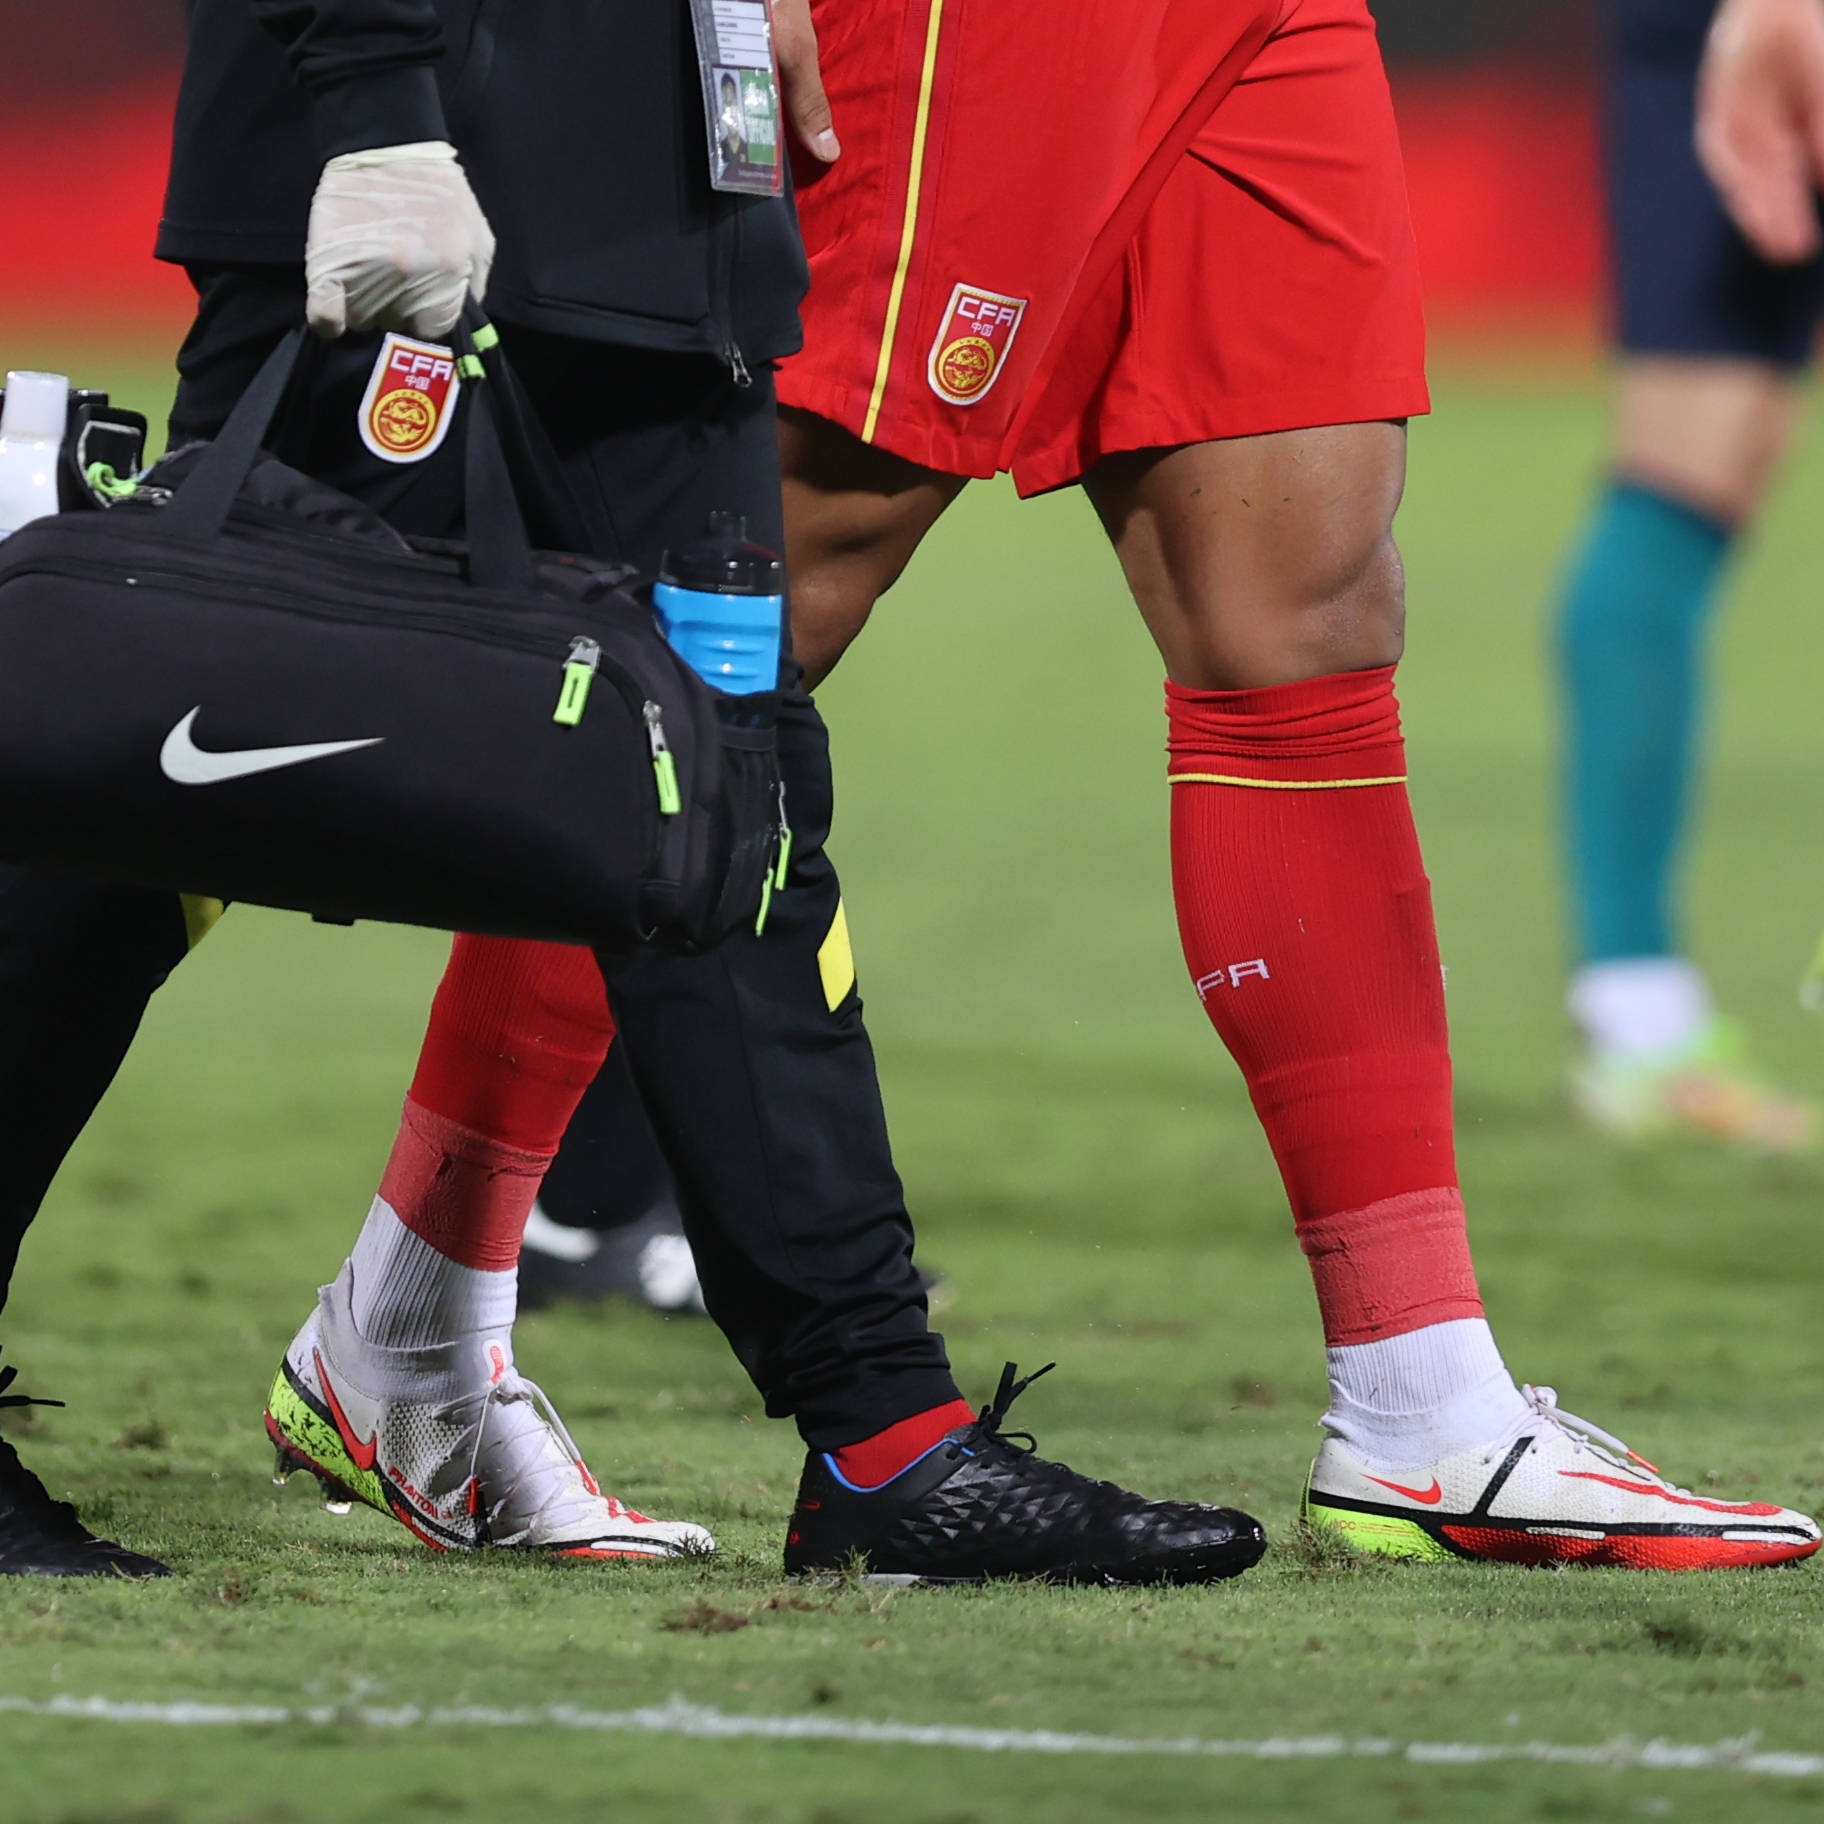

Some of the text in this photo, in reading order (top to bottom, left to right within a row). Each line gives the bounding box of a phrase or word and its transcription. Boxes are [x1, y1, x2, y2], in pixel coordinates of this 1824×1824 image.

[957, 295, 1016, 326] CFA
[390, 348, 455, 381] CFA
[404, 374, 431, 390] 中国
